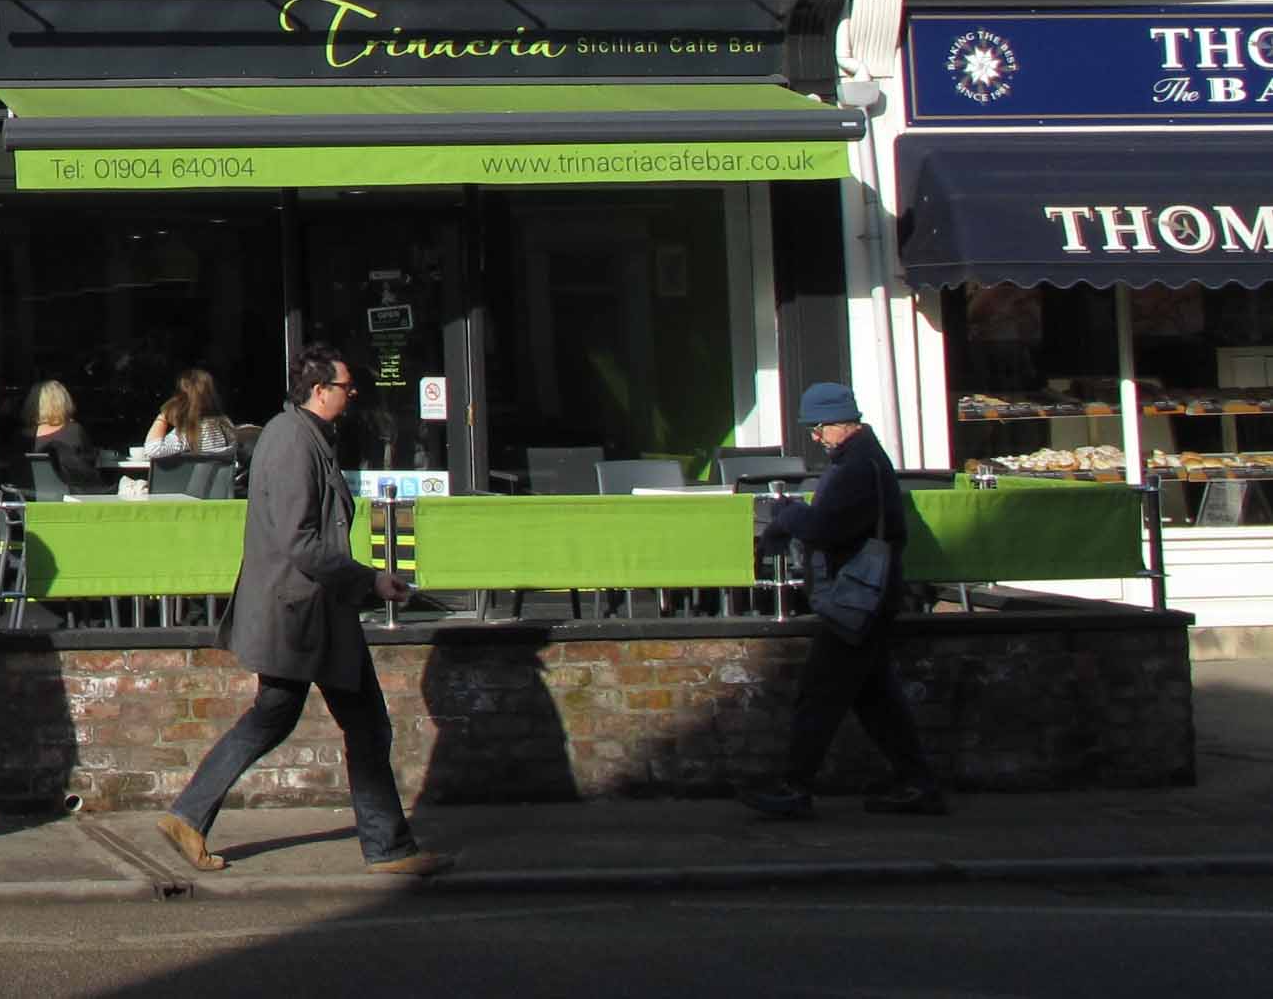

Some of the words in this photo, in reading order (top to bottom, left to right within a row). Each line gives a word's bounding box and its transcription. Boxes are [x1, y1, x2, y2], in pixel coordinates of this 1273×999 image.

[576, 37, 659, 53] Sicilian
[729, 37, 766, 53] Bar
[976, 30, 1001, 45] THE
[957, 82, 989, 102] SINCE
[1152, 77, 1199, 103] The
[50, 159, 85, 179] Tel:
[94, 158, 163, 179] 01904
[172, 157, 256, 178] 640104
[481, 149, 816, 175] www.trinacriacafebar.co.uk
